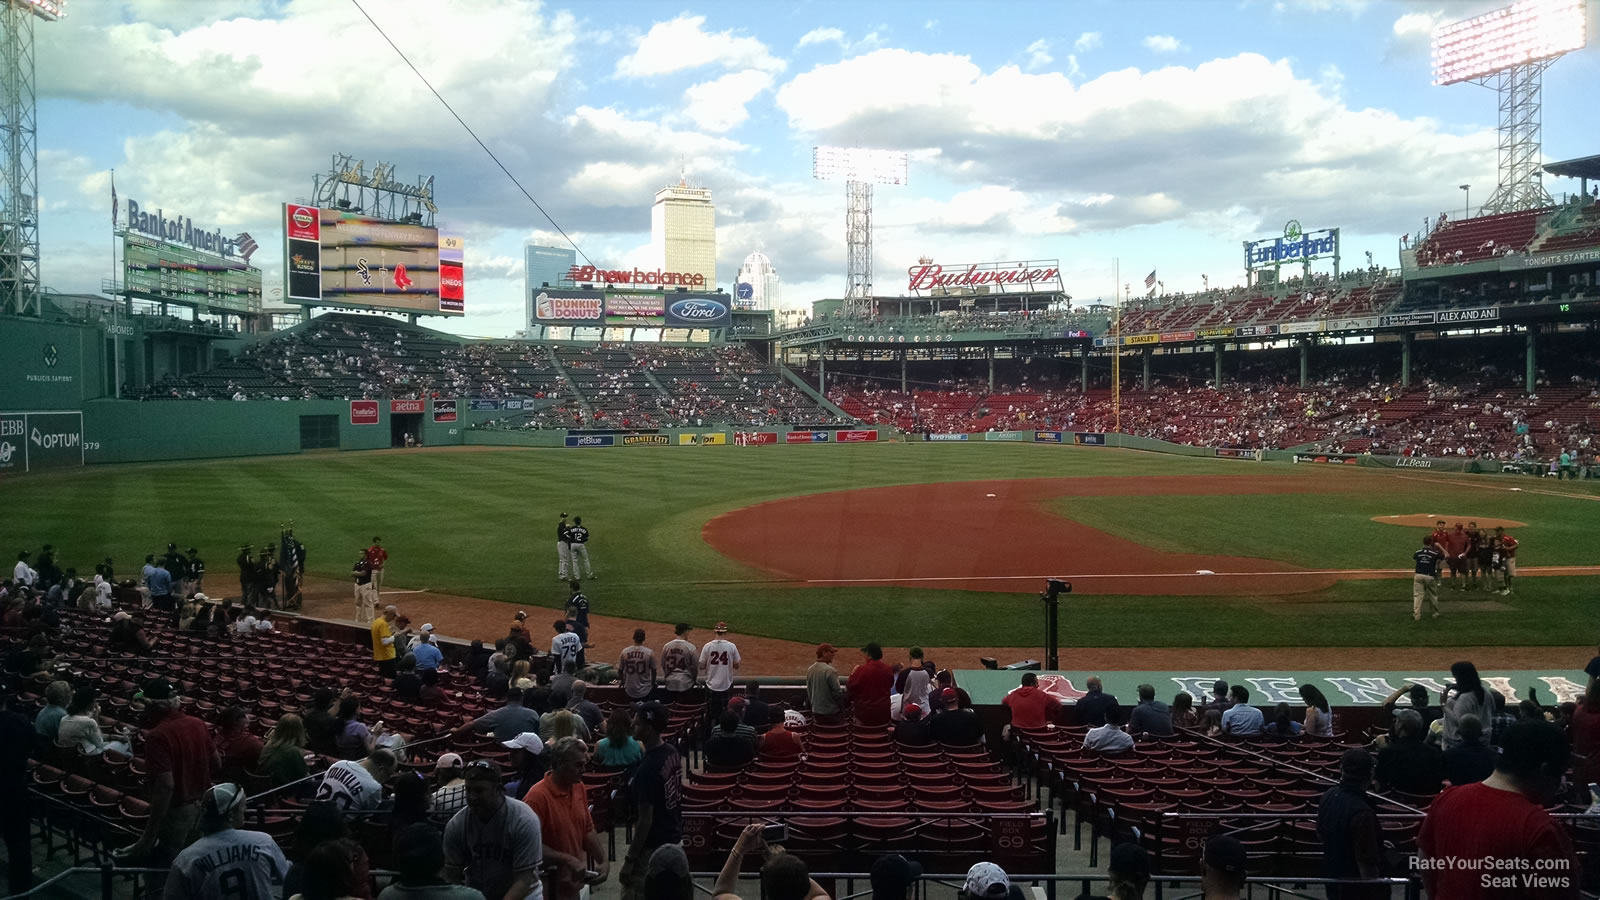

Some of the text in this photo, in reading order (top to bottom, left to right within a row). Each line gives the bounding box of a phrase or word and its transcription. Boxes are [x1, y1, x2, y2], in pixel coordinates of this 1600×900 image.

[128, 199, 167, 241] Bank
[168, 215, 183, 242] of
[185, 218, 234, 257] America
[1248, 231, 1333, 263] Cumberland
[1524, 255, 1561, 266] TONIGHT'S
[441, 278, 463, 287] ENEOS
[596, 270, 629, 284] new
[634, 267, 704, 286] balance
[908, 264, 1059, 291] Budweiser
[555, 299, 600, 309] DUNKIN'
[1560, 304, 1569, 312] VS
[555, 309, 599, 318] DONUTS
[681, 303, 716, 322] Ford
[1440, 309, 1496, 321] ALEX AND ANI
[1131, 336, 1155, 344] STANLEY
[395, 402, 420, 411] aetna
[43, 433, 80, 449] OPTUM
[578, 436, 602, 446] jetBlue
[624, 435, 653, 444] GRANITE
[653, 434, 670, 444] CITY
[690, 435, 715, 443] Non
[84, 442, 100, 450] 379
[1396, 458, 1432, 468] L.L.Bean
[574, 533, 583, 542] 12
[562, 645, 577, 659] 79
[711, 651, 728, 665] 24
[666, 656, 687, 670] 34
[327, 766, 364, 796] YOUKILIS
[682, 834, 705, 848] 69
[998, 836, 1024, 848] 69
[195, 845, 261, 875] WILLIAMS
[219, 868, 245, 900] 9
